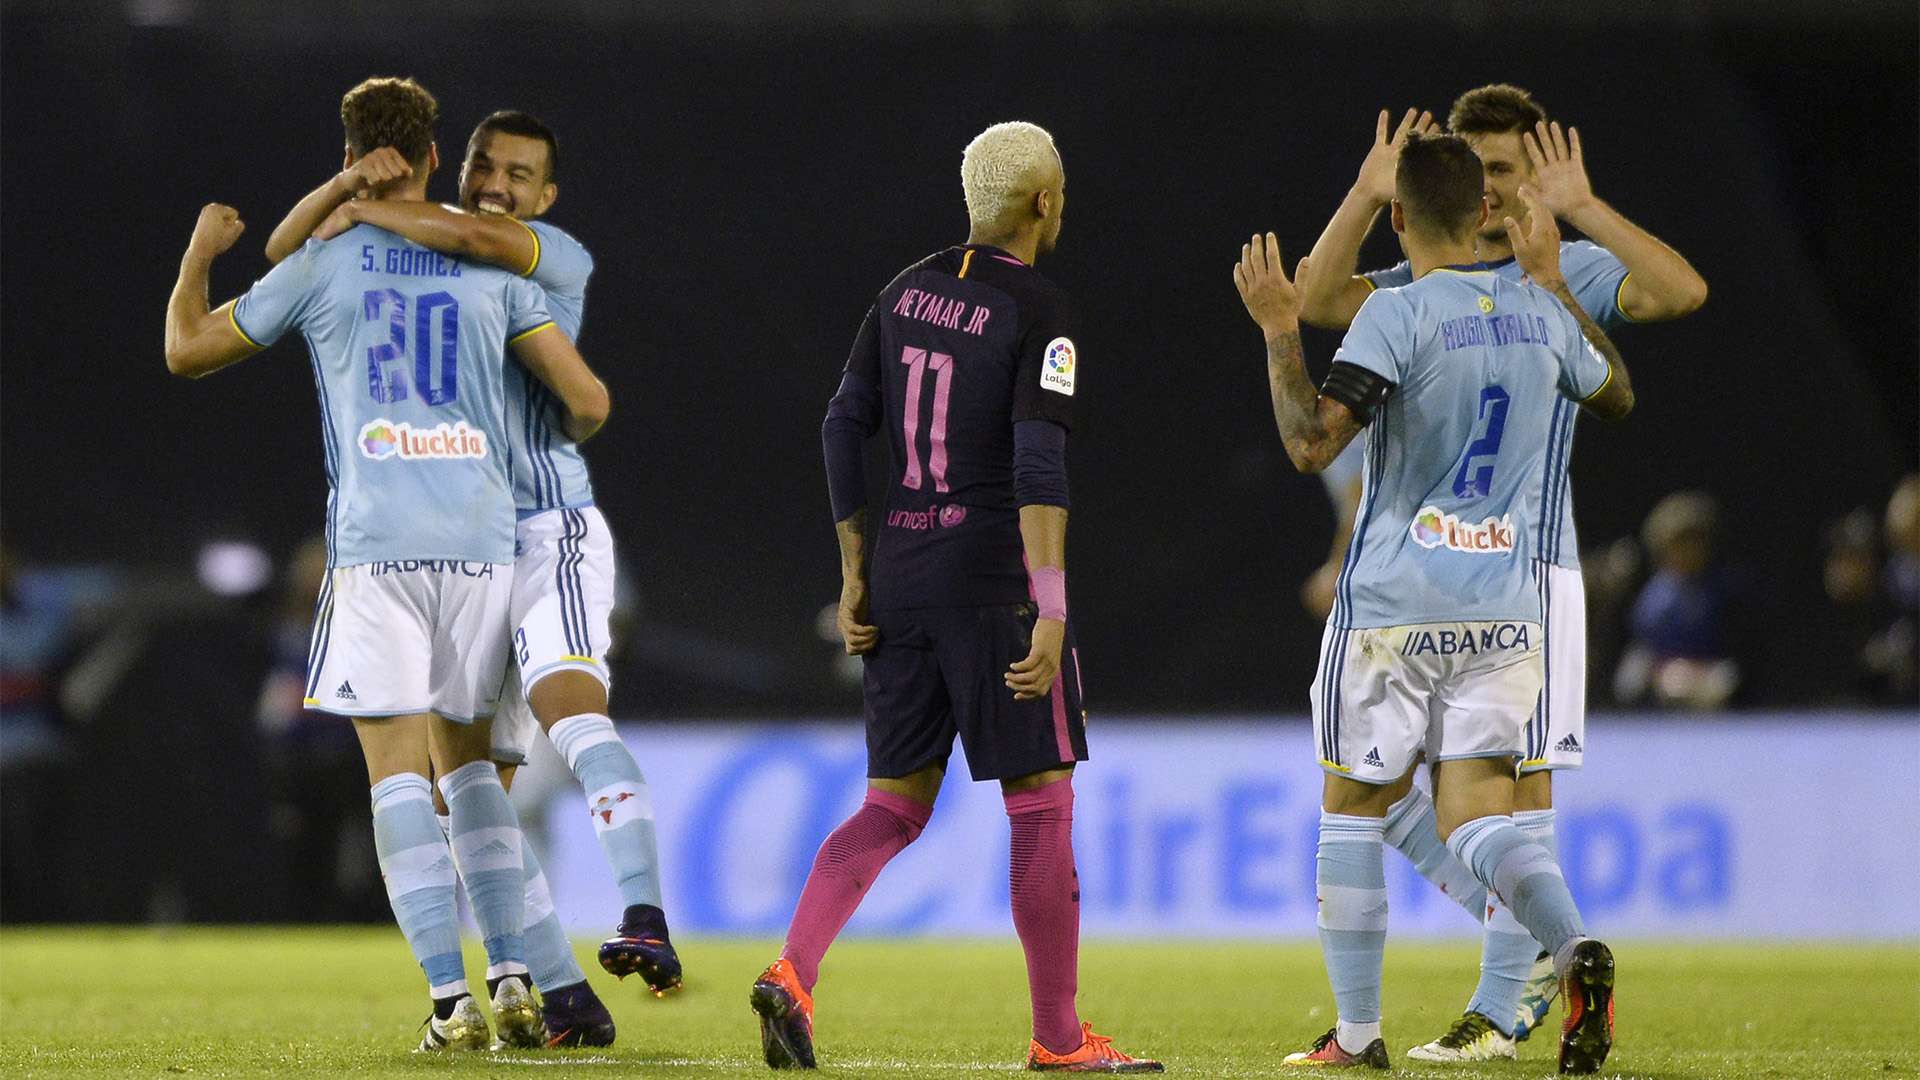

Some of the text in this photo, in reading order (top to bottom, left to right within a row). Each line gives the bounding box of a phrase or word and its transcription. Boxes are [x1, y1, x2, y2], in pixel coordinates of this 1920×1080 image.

[361, 244, 380, 272] S.
[892, 288, 990, 335] NEYMAR JR
[363, 287, 459, 407] 20
[1045, 373, 1072, 388] LaLiga
[900, 345, 953, 493] 11
[400, 428, 482, 456] luckia
[1452, 384, 1511, 498] 2
[887, 505, 938, 530] unicef
